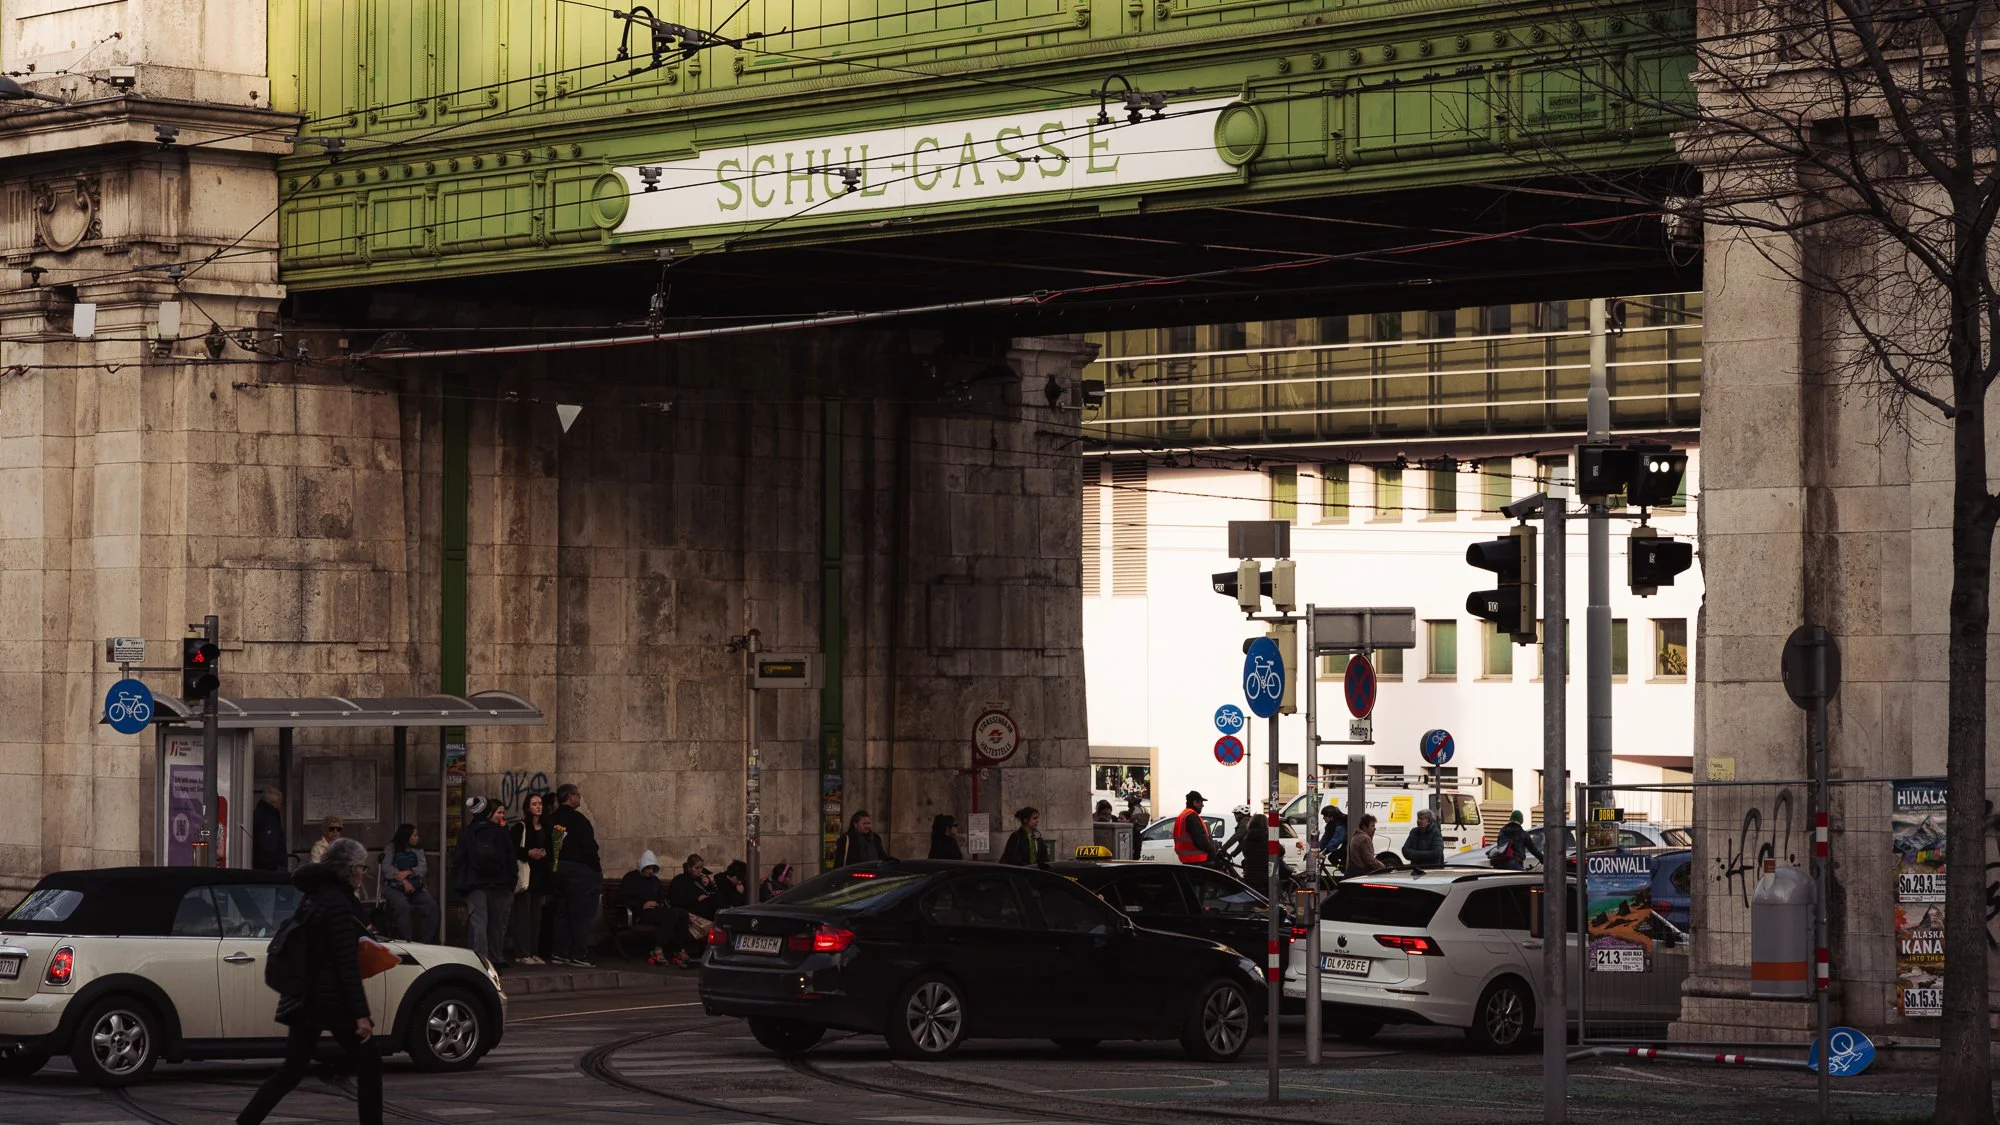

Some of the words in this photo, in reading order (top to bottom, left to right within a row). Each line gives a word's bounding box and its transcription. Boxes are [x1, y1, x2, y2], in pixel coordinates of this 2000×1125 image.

[717, 116, 1120, 212] SCHUL-GASSE
[1489, 602, 1498, 612] 10
[979, 715, 1013, 734] STRASSENBAHN
[980, 741, 1013, 757] HALTESTELLE
[1897, 790, 1948, 805] HIMALA
[1079, 848, 1099, 856] TAXI
[1588, 857, 1650, 873] CORNWALL
[1913, 931, 1944, 939] ALASKA
[1598, 951, 1623, 965] 21.3.
